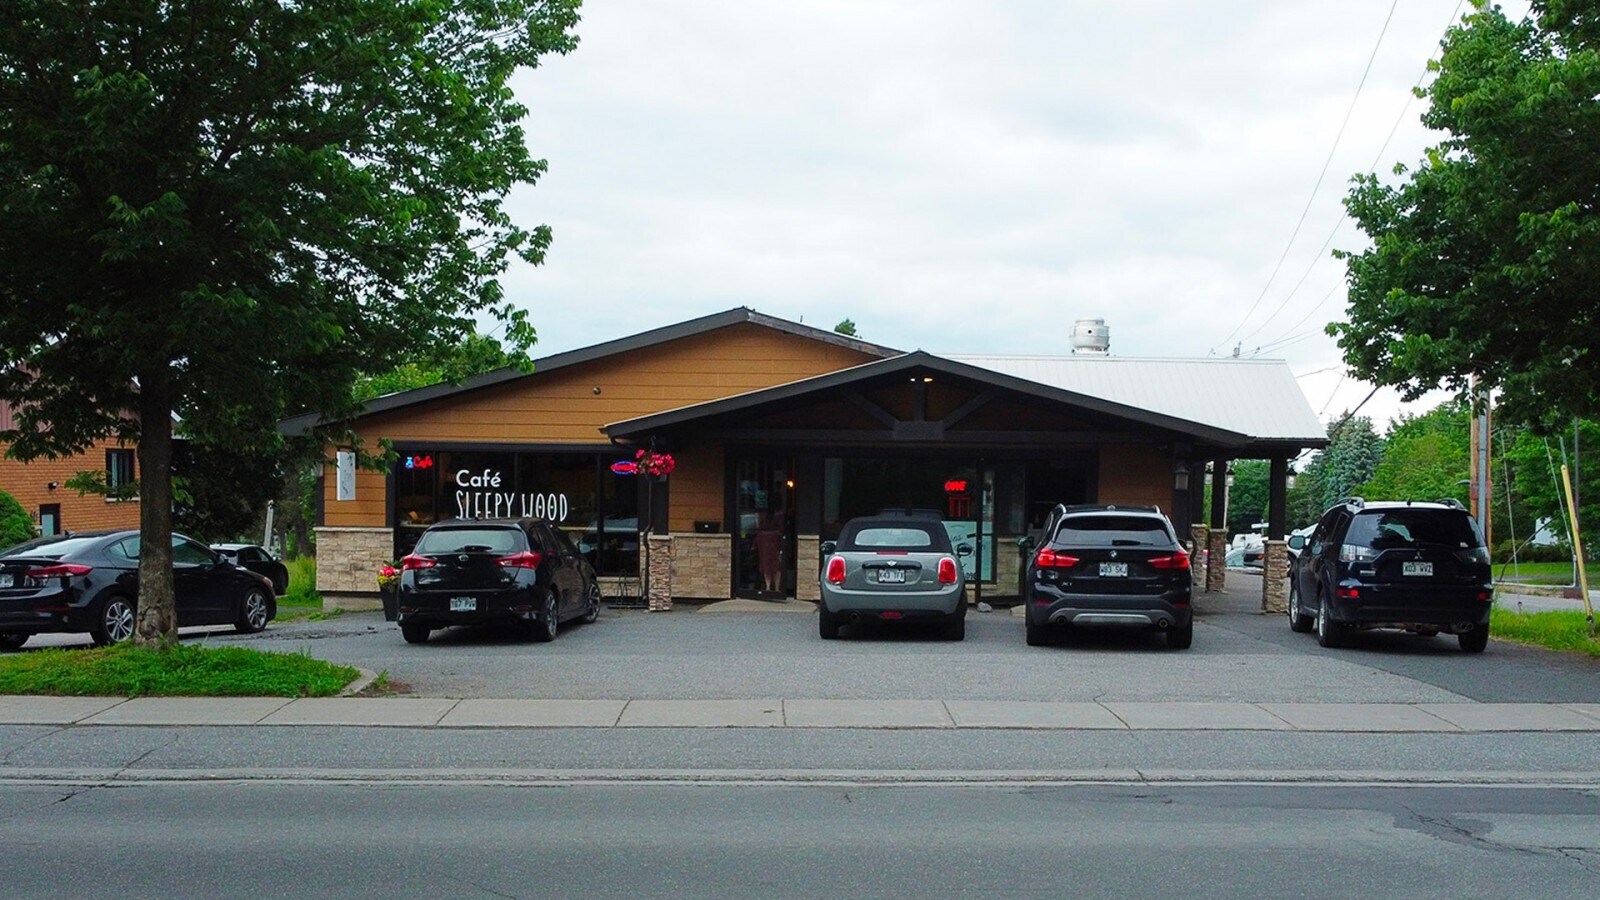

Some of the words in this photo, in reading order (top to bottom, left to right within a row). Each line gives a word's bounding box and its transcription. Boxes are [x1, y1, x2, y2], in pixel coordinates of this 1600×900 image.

[455, 468, 502, 488] Café
[455, 489, 515, 520] SLEEPY
[521, 492, 568, 522] WOOD
